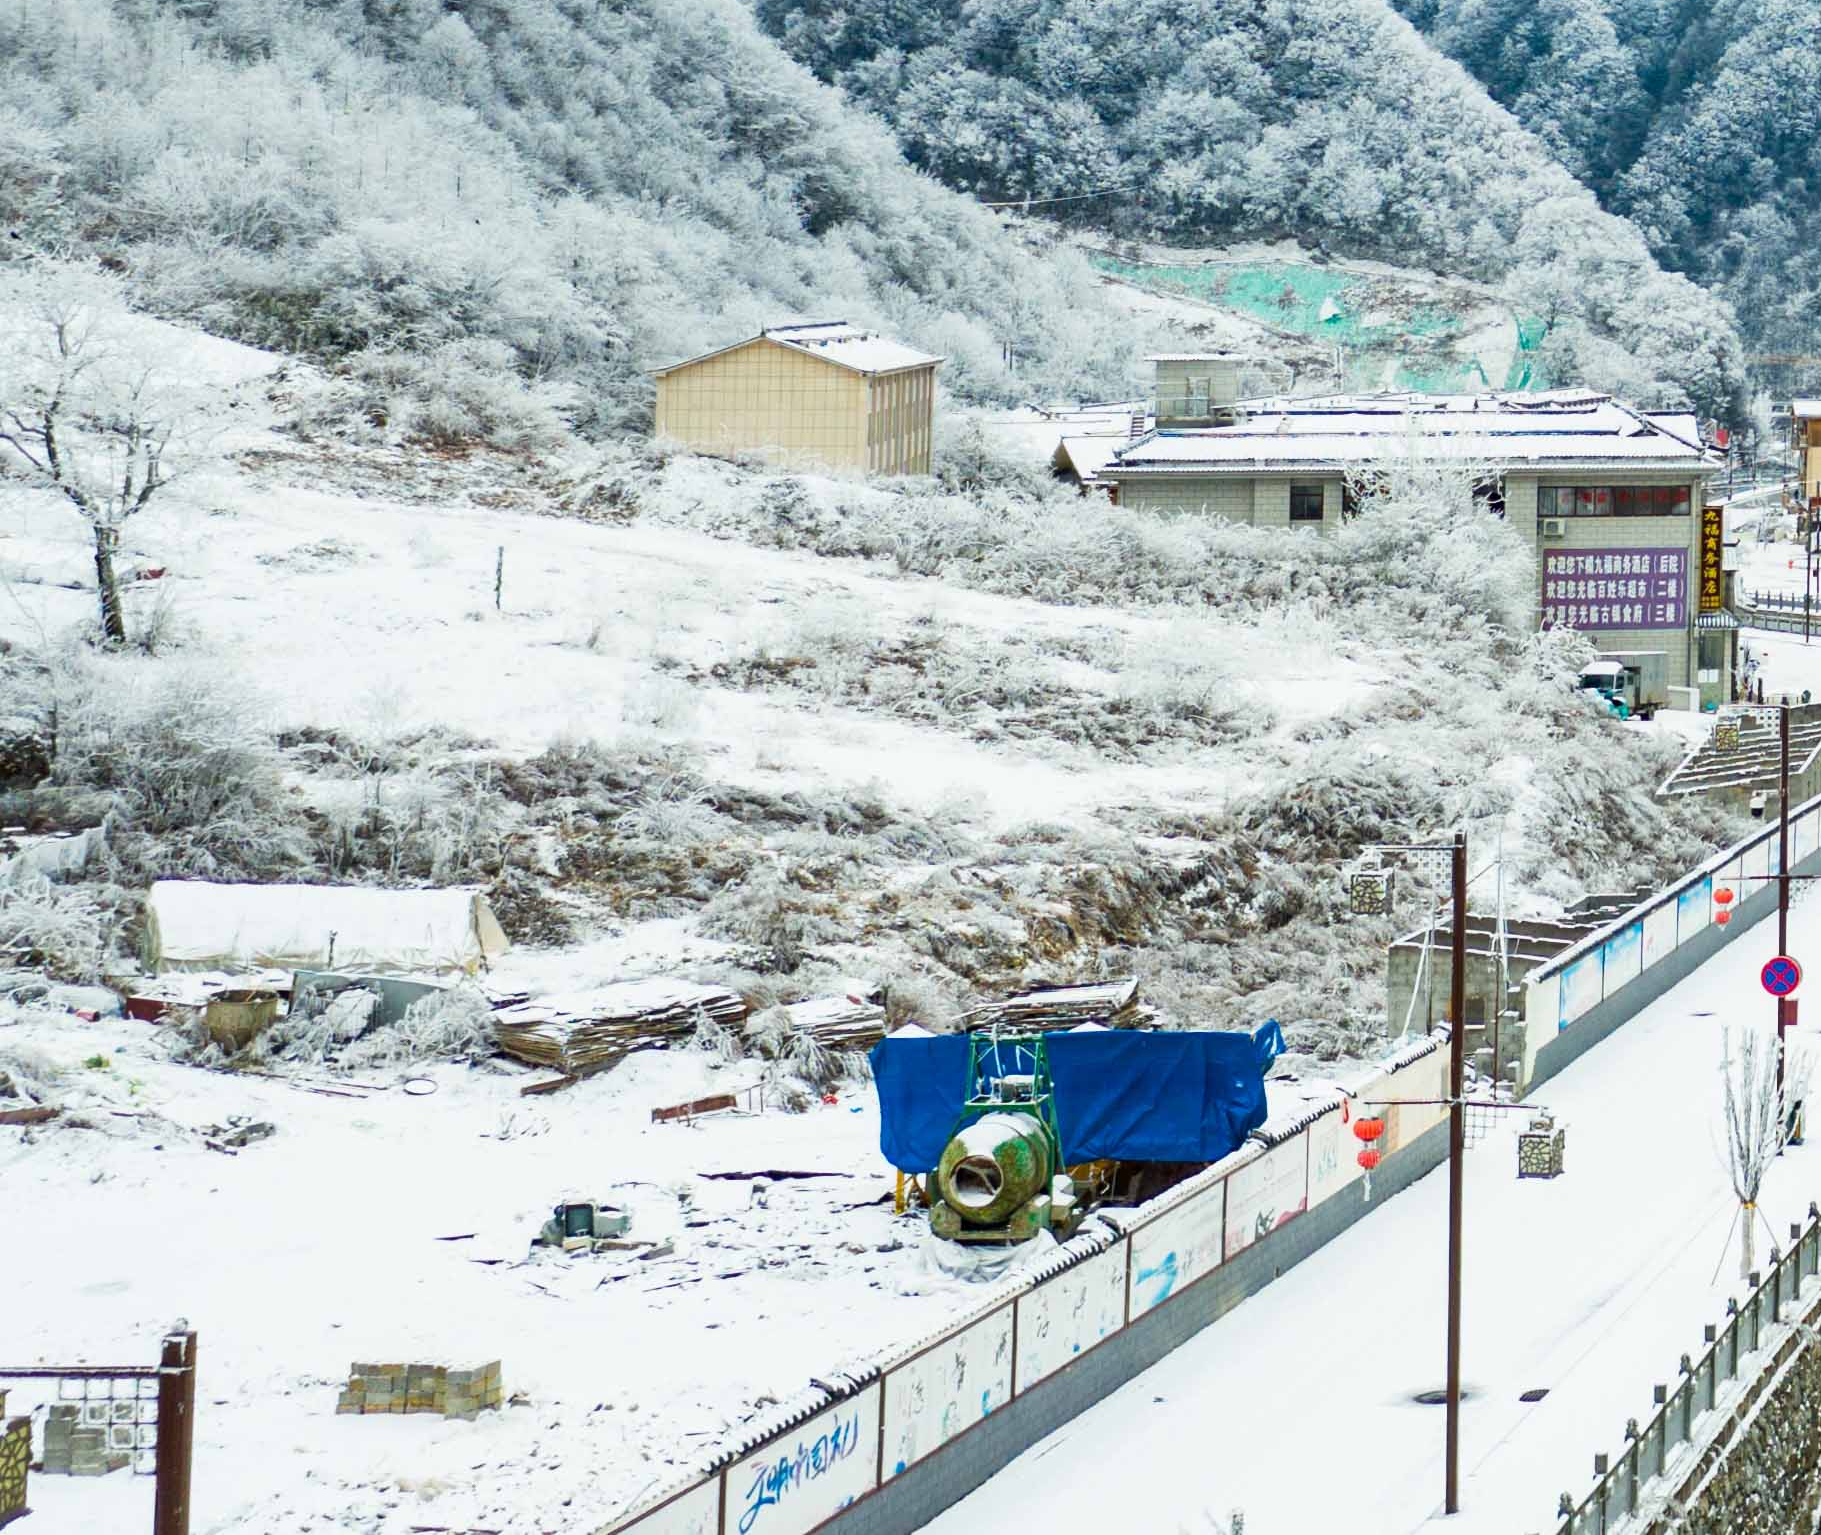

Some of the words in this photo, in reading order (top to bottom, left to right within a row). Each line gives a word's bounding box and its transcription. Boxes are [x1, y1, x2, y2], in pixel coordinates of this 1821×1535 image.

[1703, 510, 1720, 594] 九福商务酒店
